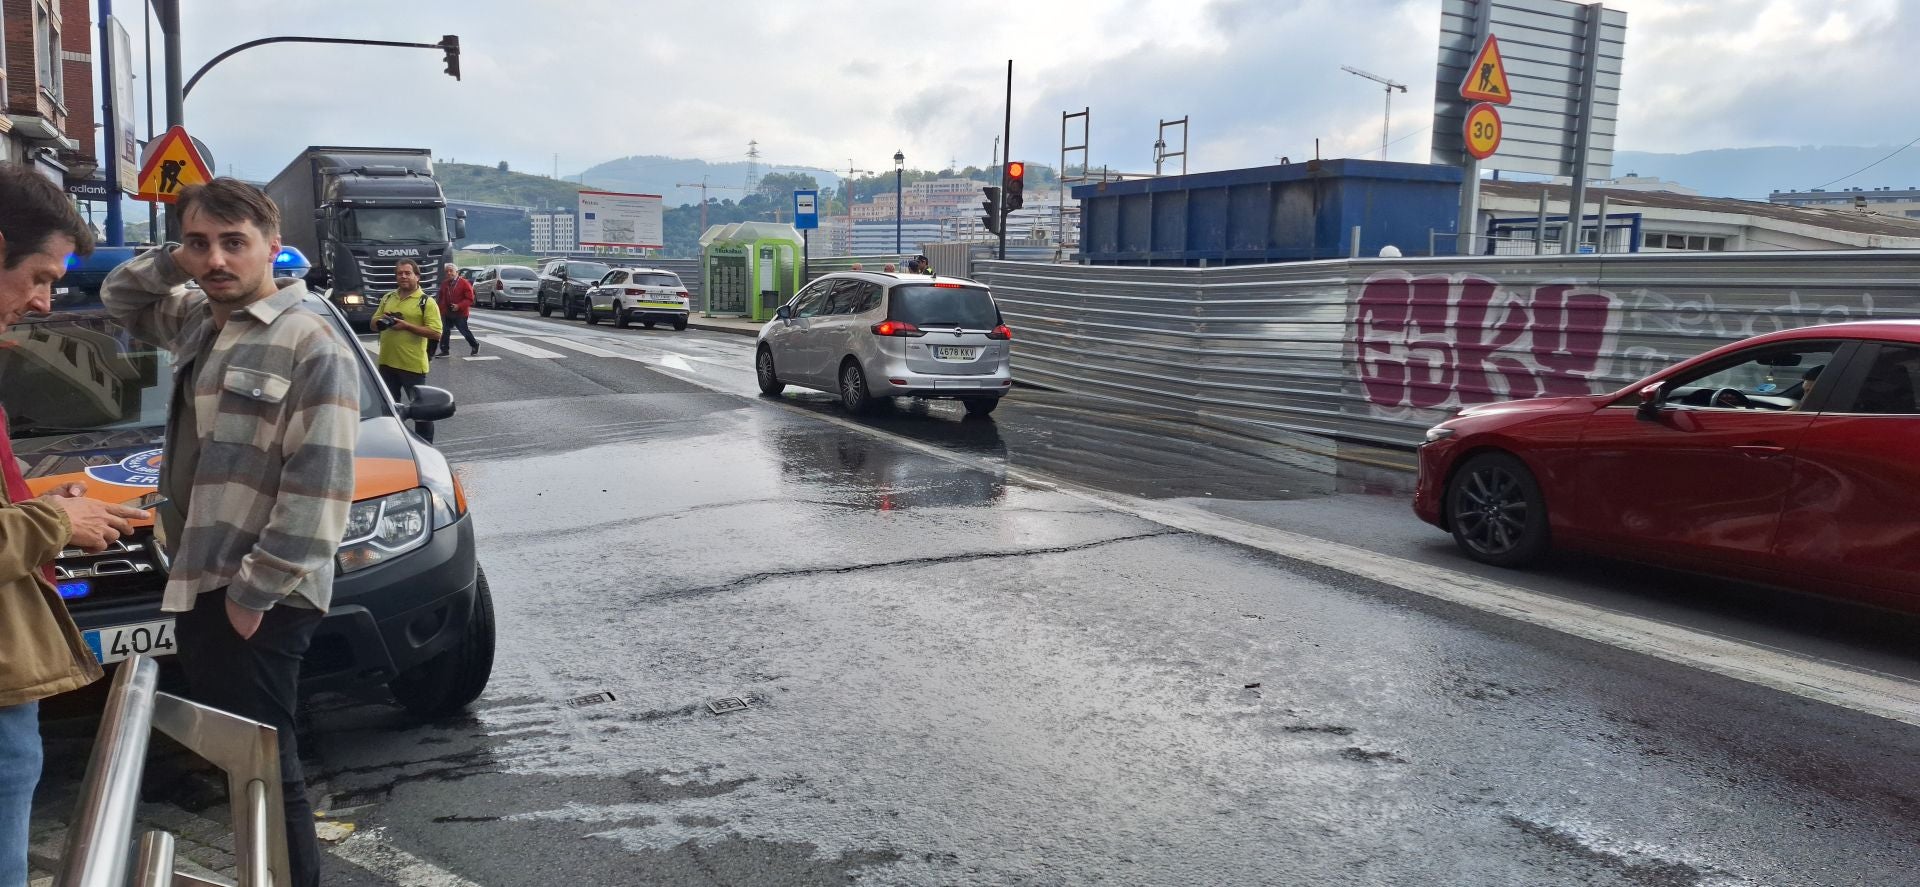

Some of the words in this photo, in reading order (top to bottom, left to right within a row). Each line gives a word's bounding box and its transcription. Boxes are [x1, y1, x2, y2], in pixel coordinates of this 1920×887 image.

[1473, 121, 1494, 140] 30
[377, 248, 419, 257] SCANIA
[939, 347, 959, 356] 4678
[960, 348, 974, 357] KKV
[110, 624, 173, 656] 404
